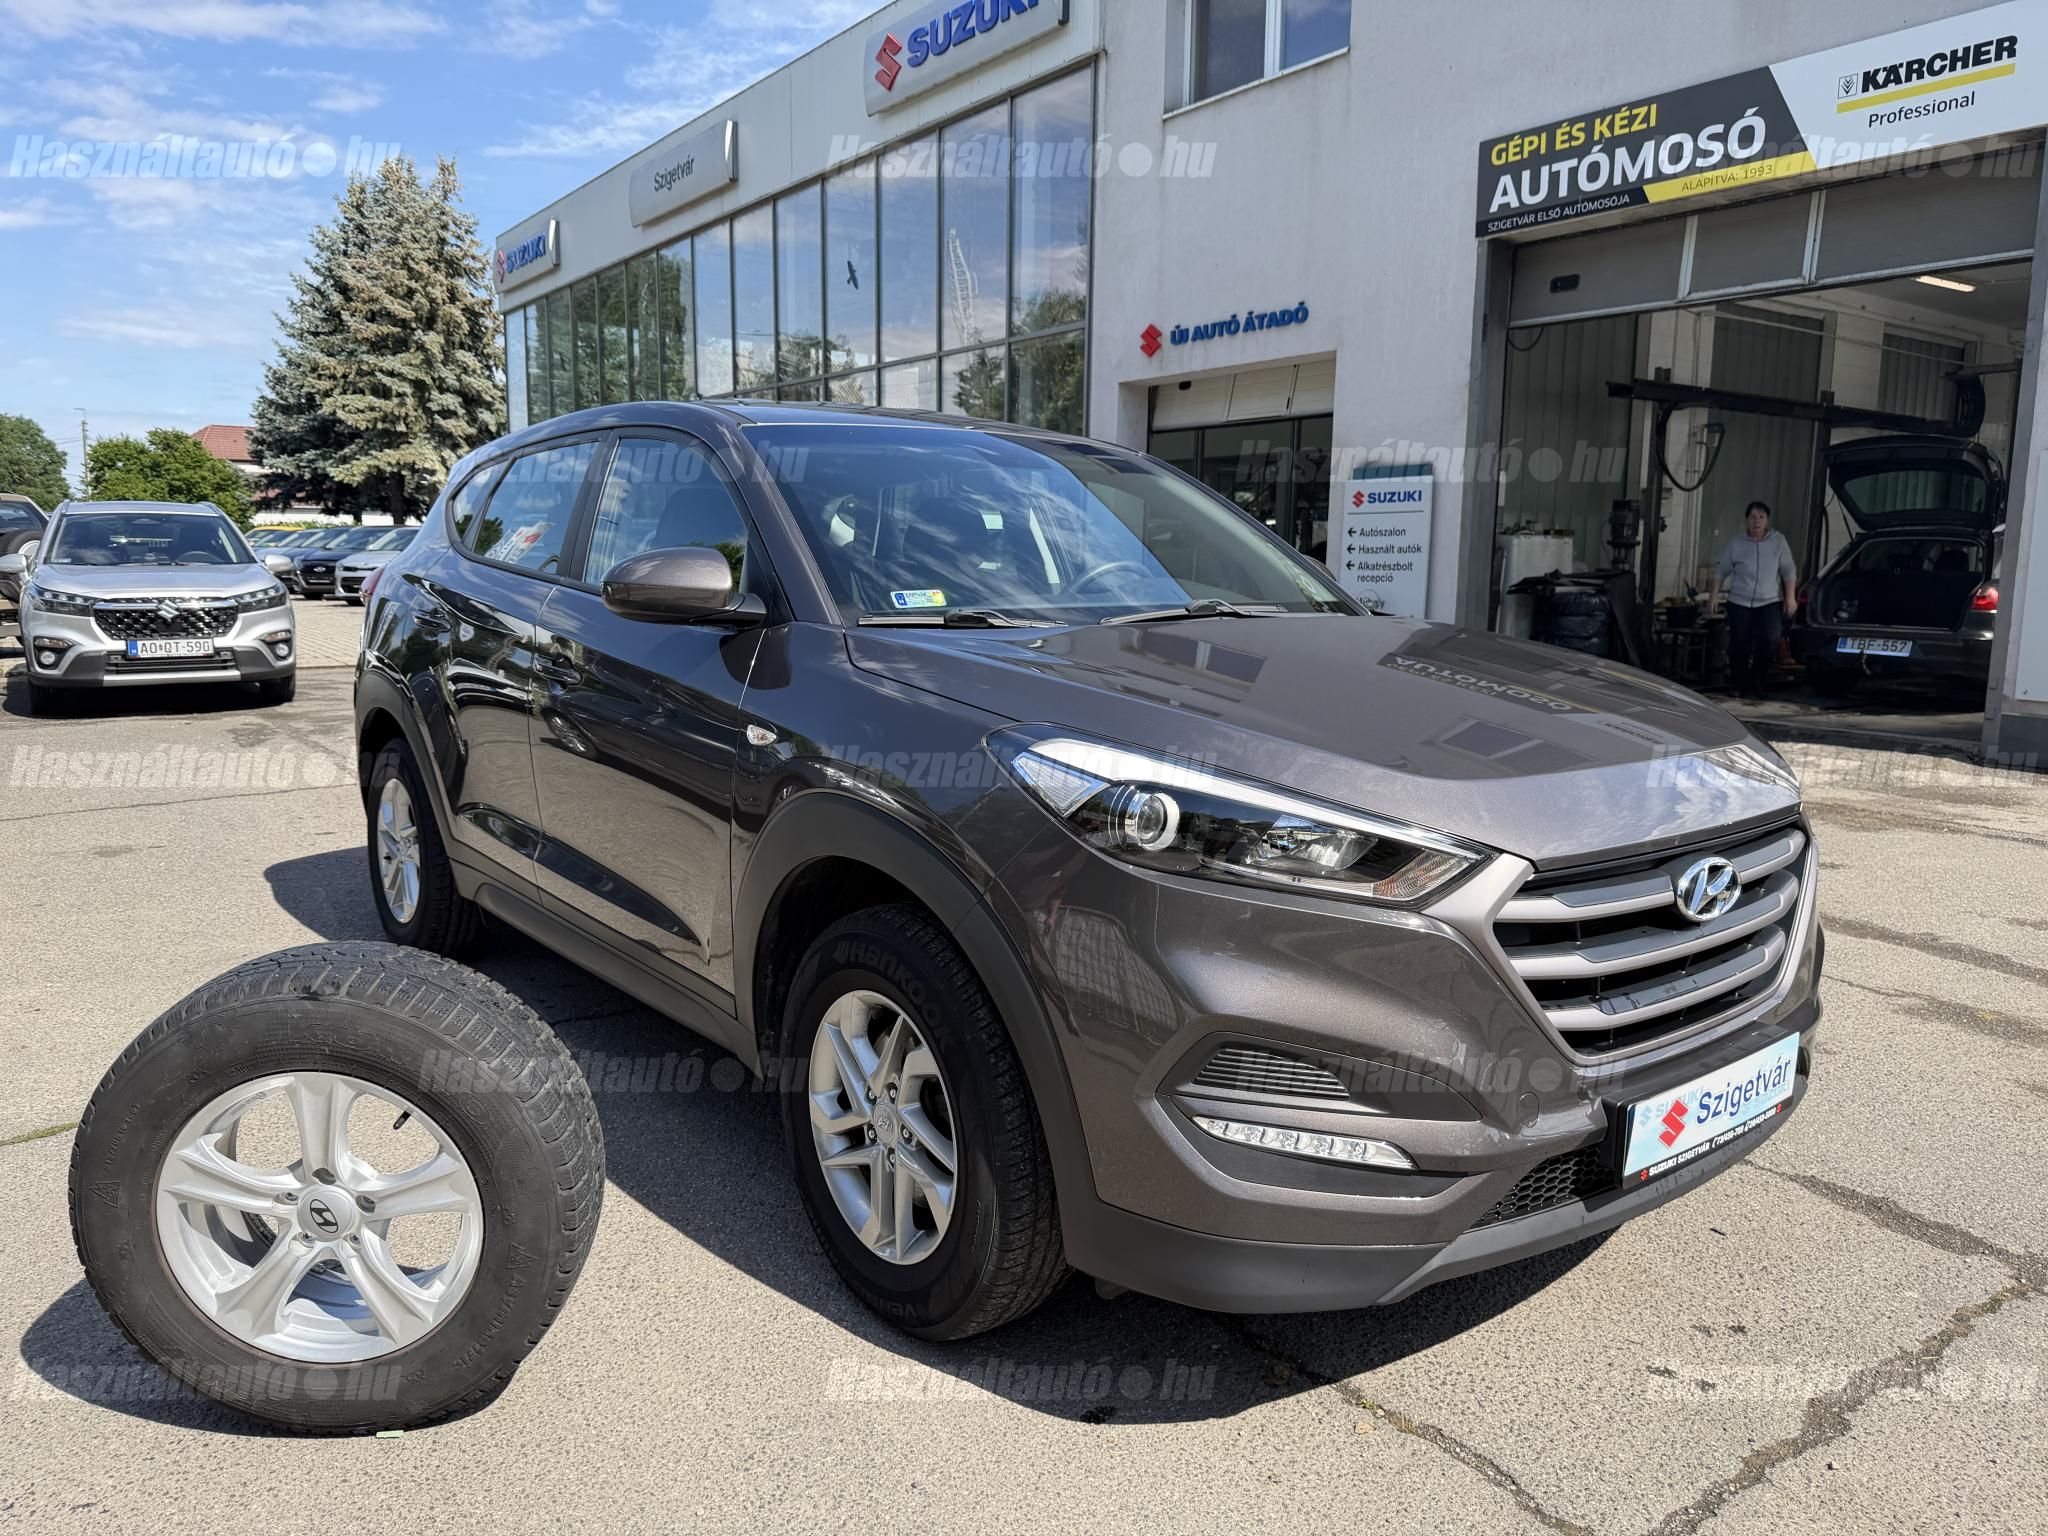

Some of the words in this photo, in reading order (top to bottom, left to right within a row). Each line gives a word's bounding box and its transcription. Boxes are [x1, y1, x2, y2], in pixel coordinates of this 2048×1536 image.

[907, 0, 1038, 68] SUZUK
[1861, 35, 2018, 93] KÄRCHER
[1868, 91, 1976, 128] Professional
[1491, 130, 1547, 166] GÉPI
[1555, 122, 1586, 151] ÉS
[1593, 103, 1657, 141] KÉZI
[653, 154, 695, 192] Szigetvár
[1489, 106, 1766, 212] AUTÓMOSÓ
[1681, 172, 1738, 192] ALAPÍTVA:
[1743, 164, 1773, 179] 1993
[1488, 214, 1535, 232] SZIGETVÁR
[1562, 194, 1630, 217] AUTÓMOSÓJA
[504, 233, 547, 274] SUZUKI
[1170, 305, 1190, 345] ÚJ
[1191, 314, 1241, 342] AUTÓ
[1242, 300, 1310, 333] ÁTADÓ
[1367, 490, 1422, 504] SUZUKI
[1358, 544, 1395, 554] Használt
[1396, 543, 1422, 554] autók
[1359, 527, 1406, 538] Autószalon
[1356, 573, 1394, 584] recepció
[1357, 560, 1413, 572] Alkatrészbolt
[1696, 1055, 1791, 1125] Szigetvár
[1678, 1142, 1710, 1163] SZIGETVÁR
